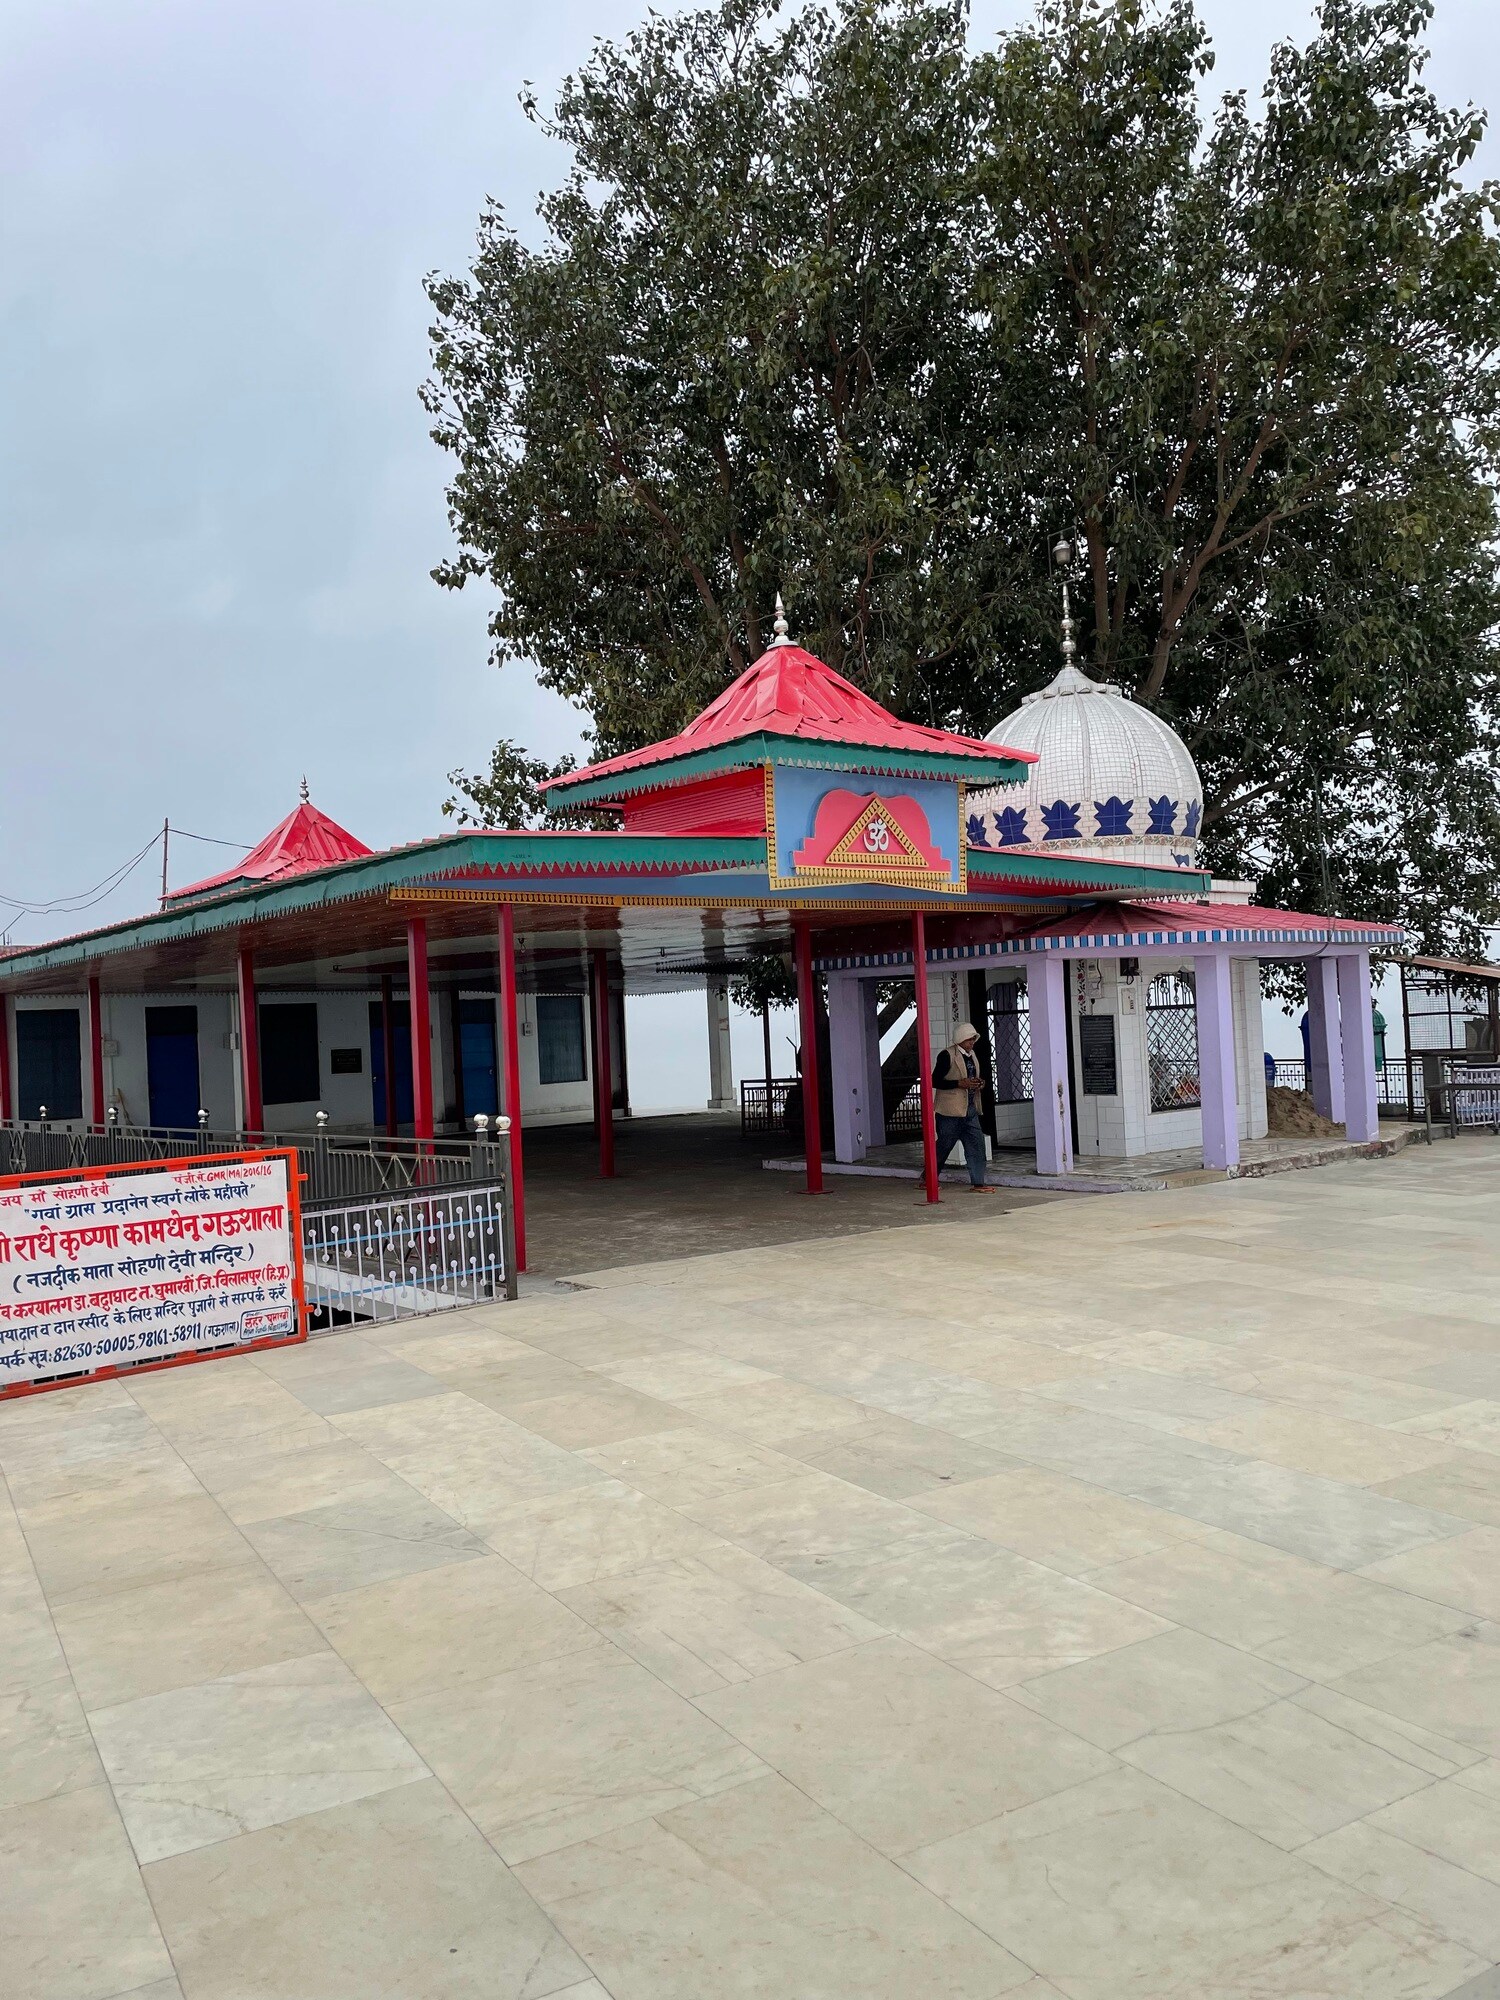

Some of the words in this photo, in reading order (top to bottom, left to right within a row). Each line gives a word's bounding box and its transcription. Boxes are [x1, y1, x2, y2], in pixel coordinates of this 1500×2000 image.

[53, 1184, 89, 1201] सोहणी
[91, 1181, 110, 1197] देवी
[65, 1202, 95, 1219] ग्रास
[101, 1193, 148, 1216] प्रदानेन
[151, 1188, 182, 1208] स्वर्ग
[184, 1184, 210, 1203] लोके
[14, 1224, 58, 1261] राधे
[59, 1224, 120, 1261] कृष्णा
[201, 1204, 284, 1238] गऊशाला
[82, 1263, 114, 1281] माता
[117, 1256, 165, 1277] सोहणी
[167, 1249, 196, 1273] देवी
[13, 1296, 73, 1320] करयालग
[40, 1323, 51, 1336] व
[54, 1319, 76, 1335] दान
[78, 1312, 109, 1332] रसीद
[113, 1307, 126, 1325] के
[125, 1305, 152, 1323] लिए
[154, 1300, 185, 1319] मन्दिर
[188, 1294, 217, 1317] पुजारी
[219, 1290, 229, 1308] से
[232, 1285, 265, 1306] सम्पर्क
[268, 1282, 287, 1301] करें
